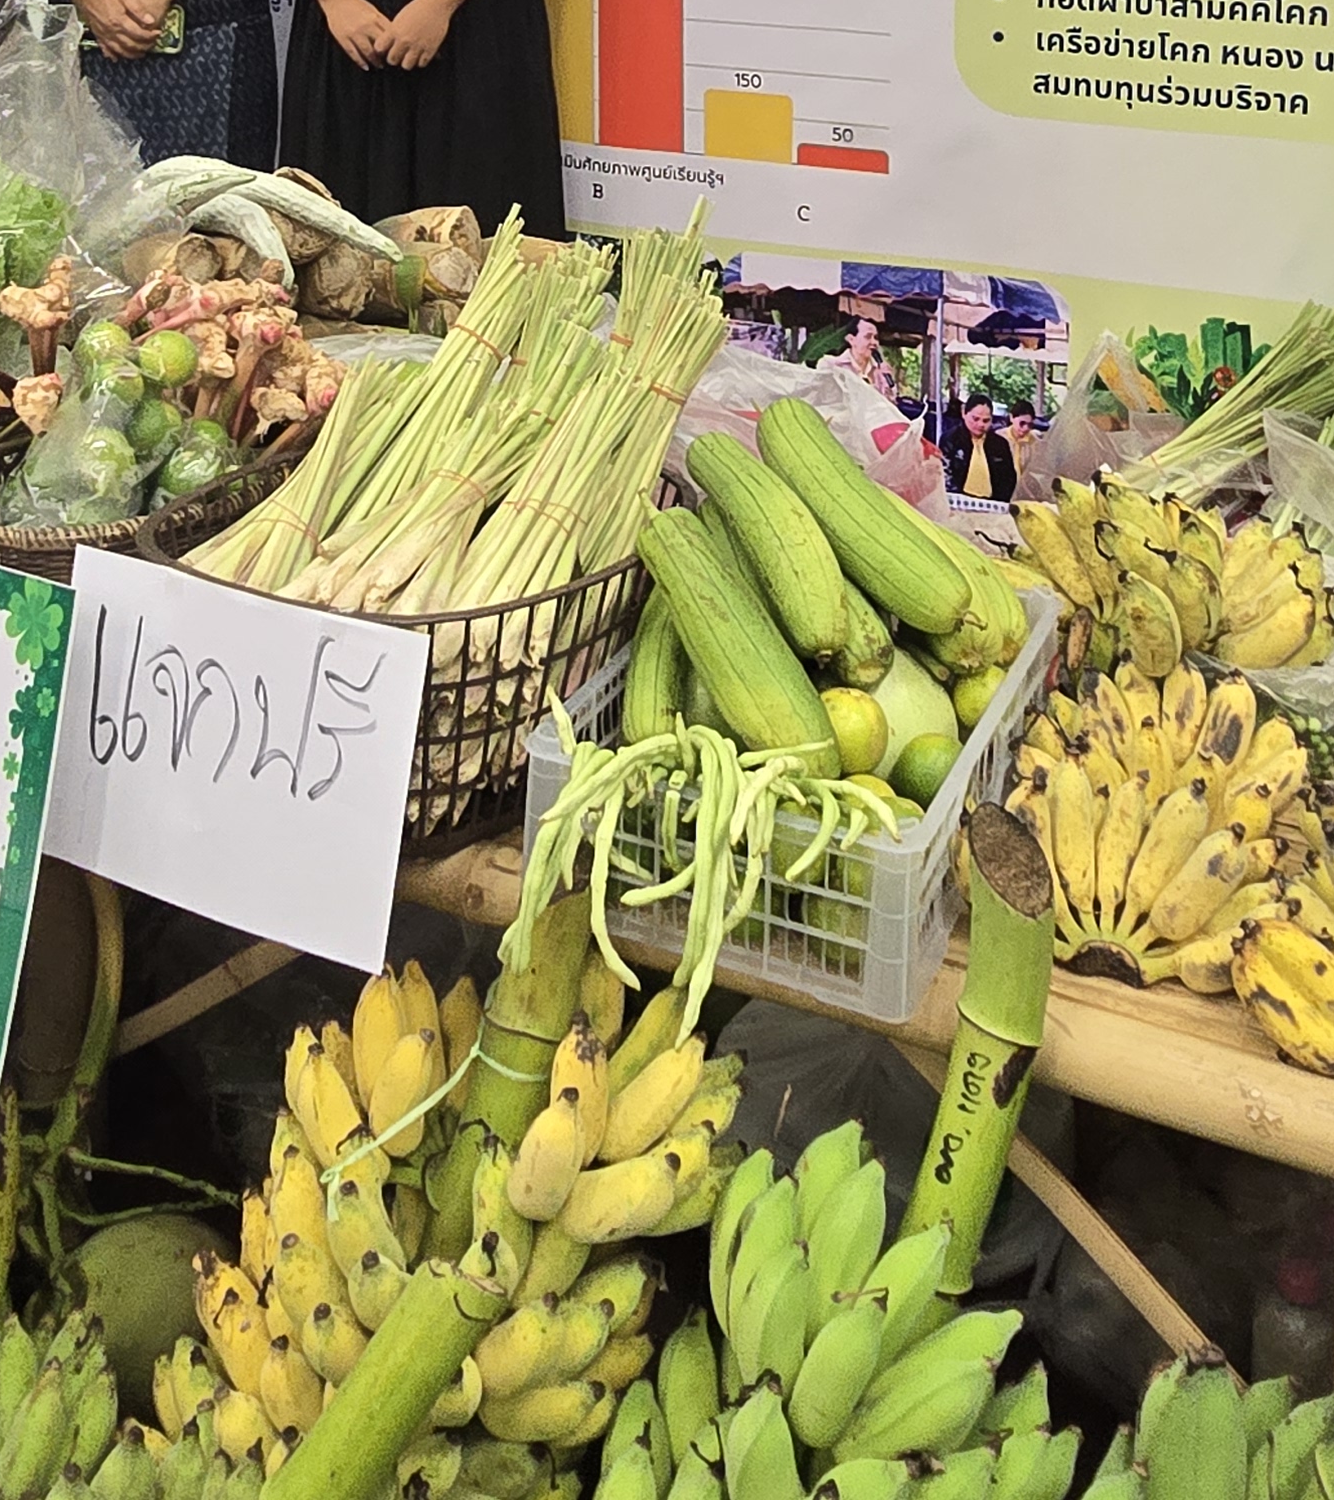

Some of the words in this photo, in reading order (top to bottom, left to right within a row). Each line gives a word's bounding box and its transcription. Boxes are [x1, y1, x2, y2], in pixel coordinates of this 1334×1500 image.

[1036, 26, 1210, 64] เครือข่ายโคก
[1221, 45, 1304, 71] หนอง
[734, 73, 762, 89] 150
[1033, 72, 1310, 115] สมทบทุนร่วมบริจาค
[832, 127, 854, 142] 50
[593, 184, 604, 199] B
[798, 205, 811, 222] C
